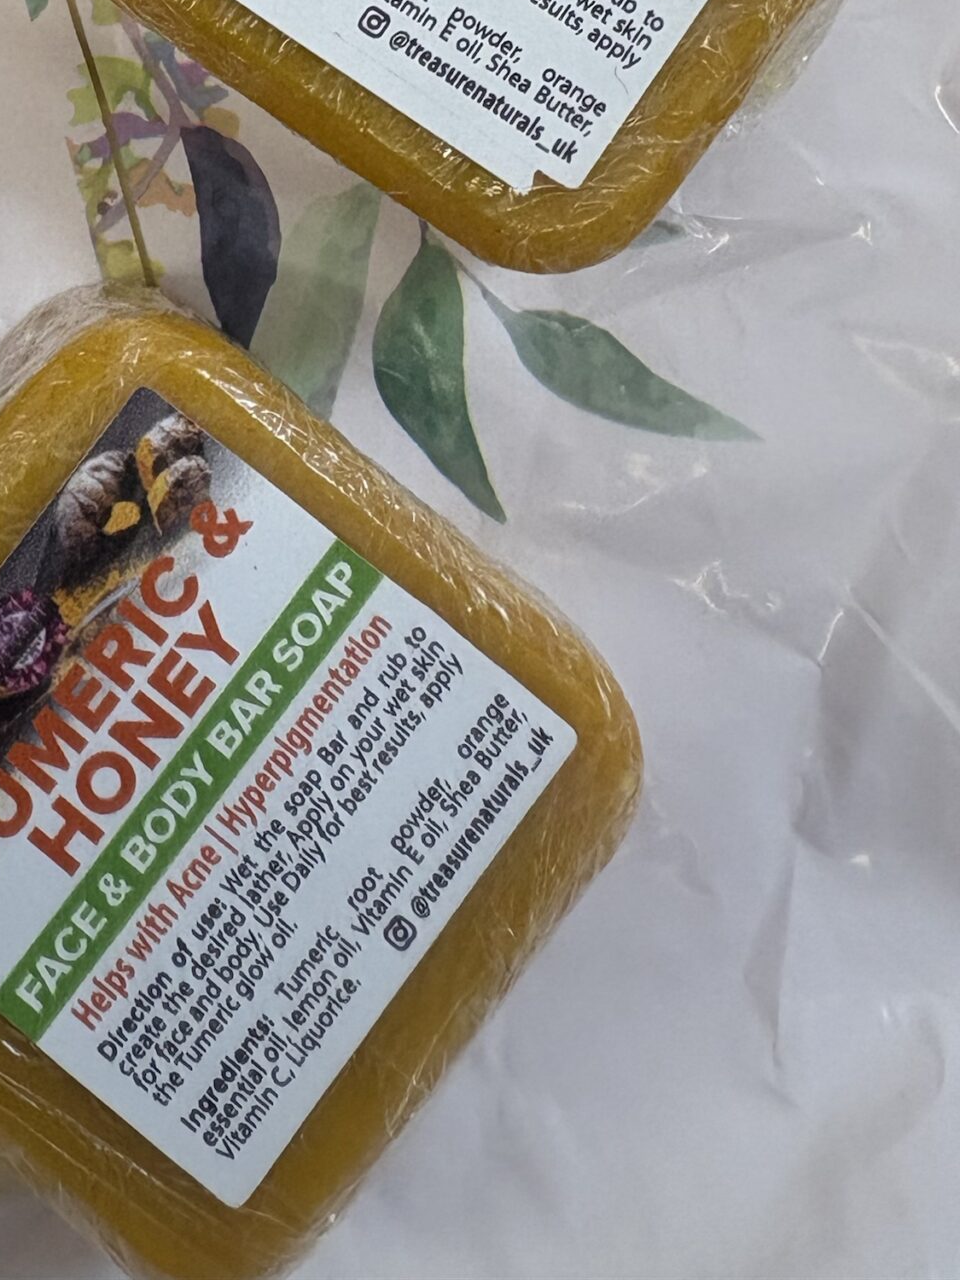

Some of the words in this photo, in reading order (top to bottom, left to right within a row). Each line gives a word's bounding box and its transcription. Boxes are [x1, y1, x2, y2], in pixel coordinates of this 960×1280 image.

[438, 21, 456, 42] E
[456, 37, 483, 64] oil,
[485, 53, 531, 94] Shea
[533, 85, 593, 137] Butter,
[446, 6, 522, 64] powder,
[541, 68, 606, 117] orange
[587, 28, 641, 69] apply
[612, 19, 651, 50] skin
[643, 10, 664, 32] to
[389, 30, 577, 163] @treasurenaturals_uk
[188, 499, 251, 556] &
[15, 900, 107, 1012] FACE
[98, 872, 131, 906] &
[120, 750, 213, 873] BODY
[205, 668, 282, 759] BAR
[272, 560, 353, 671] SOAP
[30, 602, 238, 873] HONEY
[74, 958, 135, 1027] Helps
[127, 903, 176, 960] with
[167, 844, 221, 905] Acne
[215, 615, 389, 834] Hyperpigmentation
[410, 726, 553, 918] @treasurenaturals_uk
[180, 1013, 275, 1132] Ingredients:
[274, 924, 340, 1000] Tumeric
[347, 866, 383, 911] root
[390, 777, 451, 855] powder,
[457, 693, 509, 760] orange
[202, 1059, 267, 1146] essential
[264, 1031, 295, 1062] oil,
[282, 968, 337, 1032] lemon
[333, 937, 362, 968] oil,
[350, 865, 413, 935] Vitamin
[403, 845, 425, 865] E
[421, 817, 449, 848] oil,
[440, 770, 481, 817] Shea
[474, 708, 528, 770] Butter,
